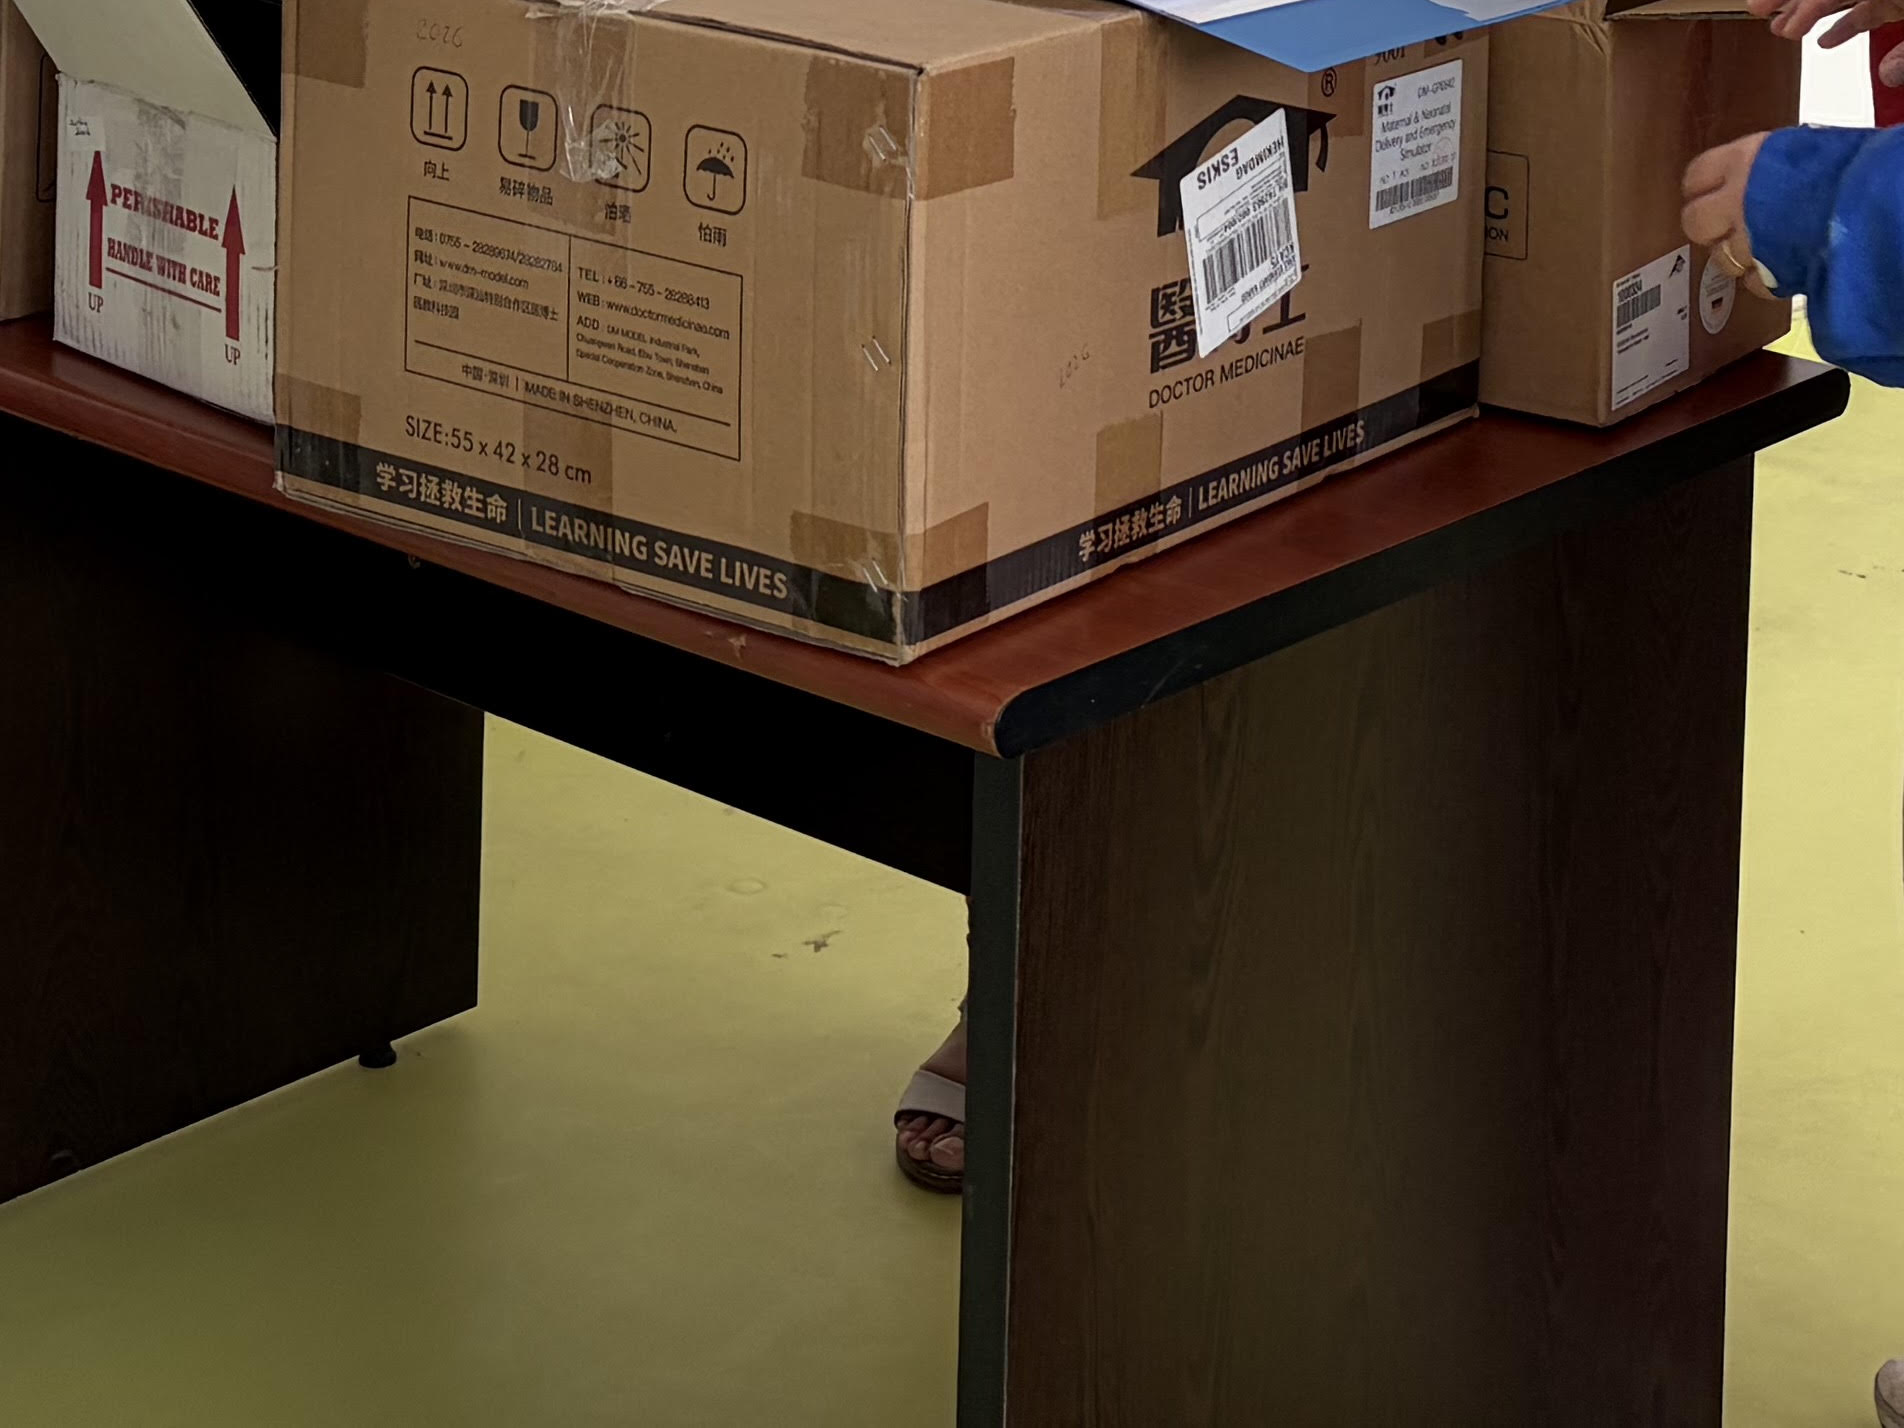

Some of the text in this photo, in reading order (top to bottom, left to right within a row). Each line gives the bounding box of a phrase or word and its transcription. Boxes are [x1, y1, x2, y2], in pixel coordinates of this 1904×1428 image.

[423, 160, 451, 182] 向上
[499, 176, 554, 206] 易碎物品
[1196, 146, 1239, 190] ESKIS
[1484, 186, 1509, 220] C
[107, 237, 221, 297] HANDLE WITH CARE
[88, 292, 104, 313] UP
[225, 343, 241, 365] UP
[1148, 335, 1305, 410] DOCTOR MEDICINAE
[492, 439, 516, 465] 42
[535, 450, 560, 477] 28
[564, 463, 592, 486] cm
[1198, 419, 1367, 511] LEARNING SAVE LIVES
[375, 461, 509, 525] 学习拯救生命
[1079, 493, 1183, 563] 学习拯救生命
[531, 506, 789, 600] LEARNING SAVE LIVES
